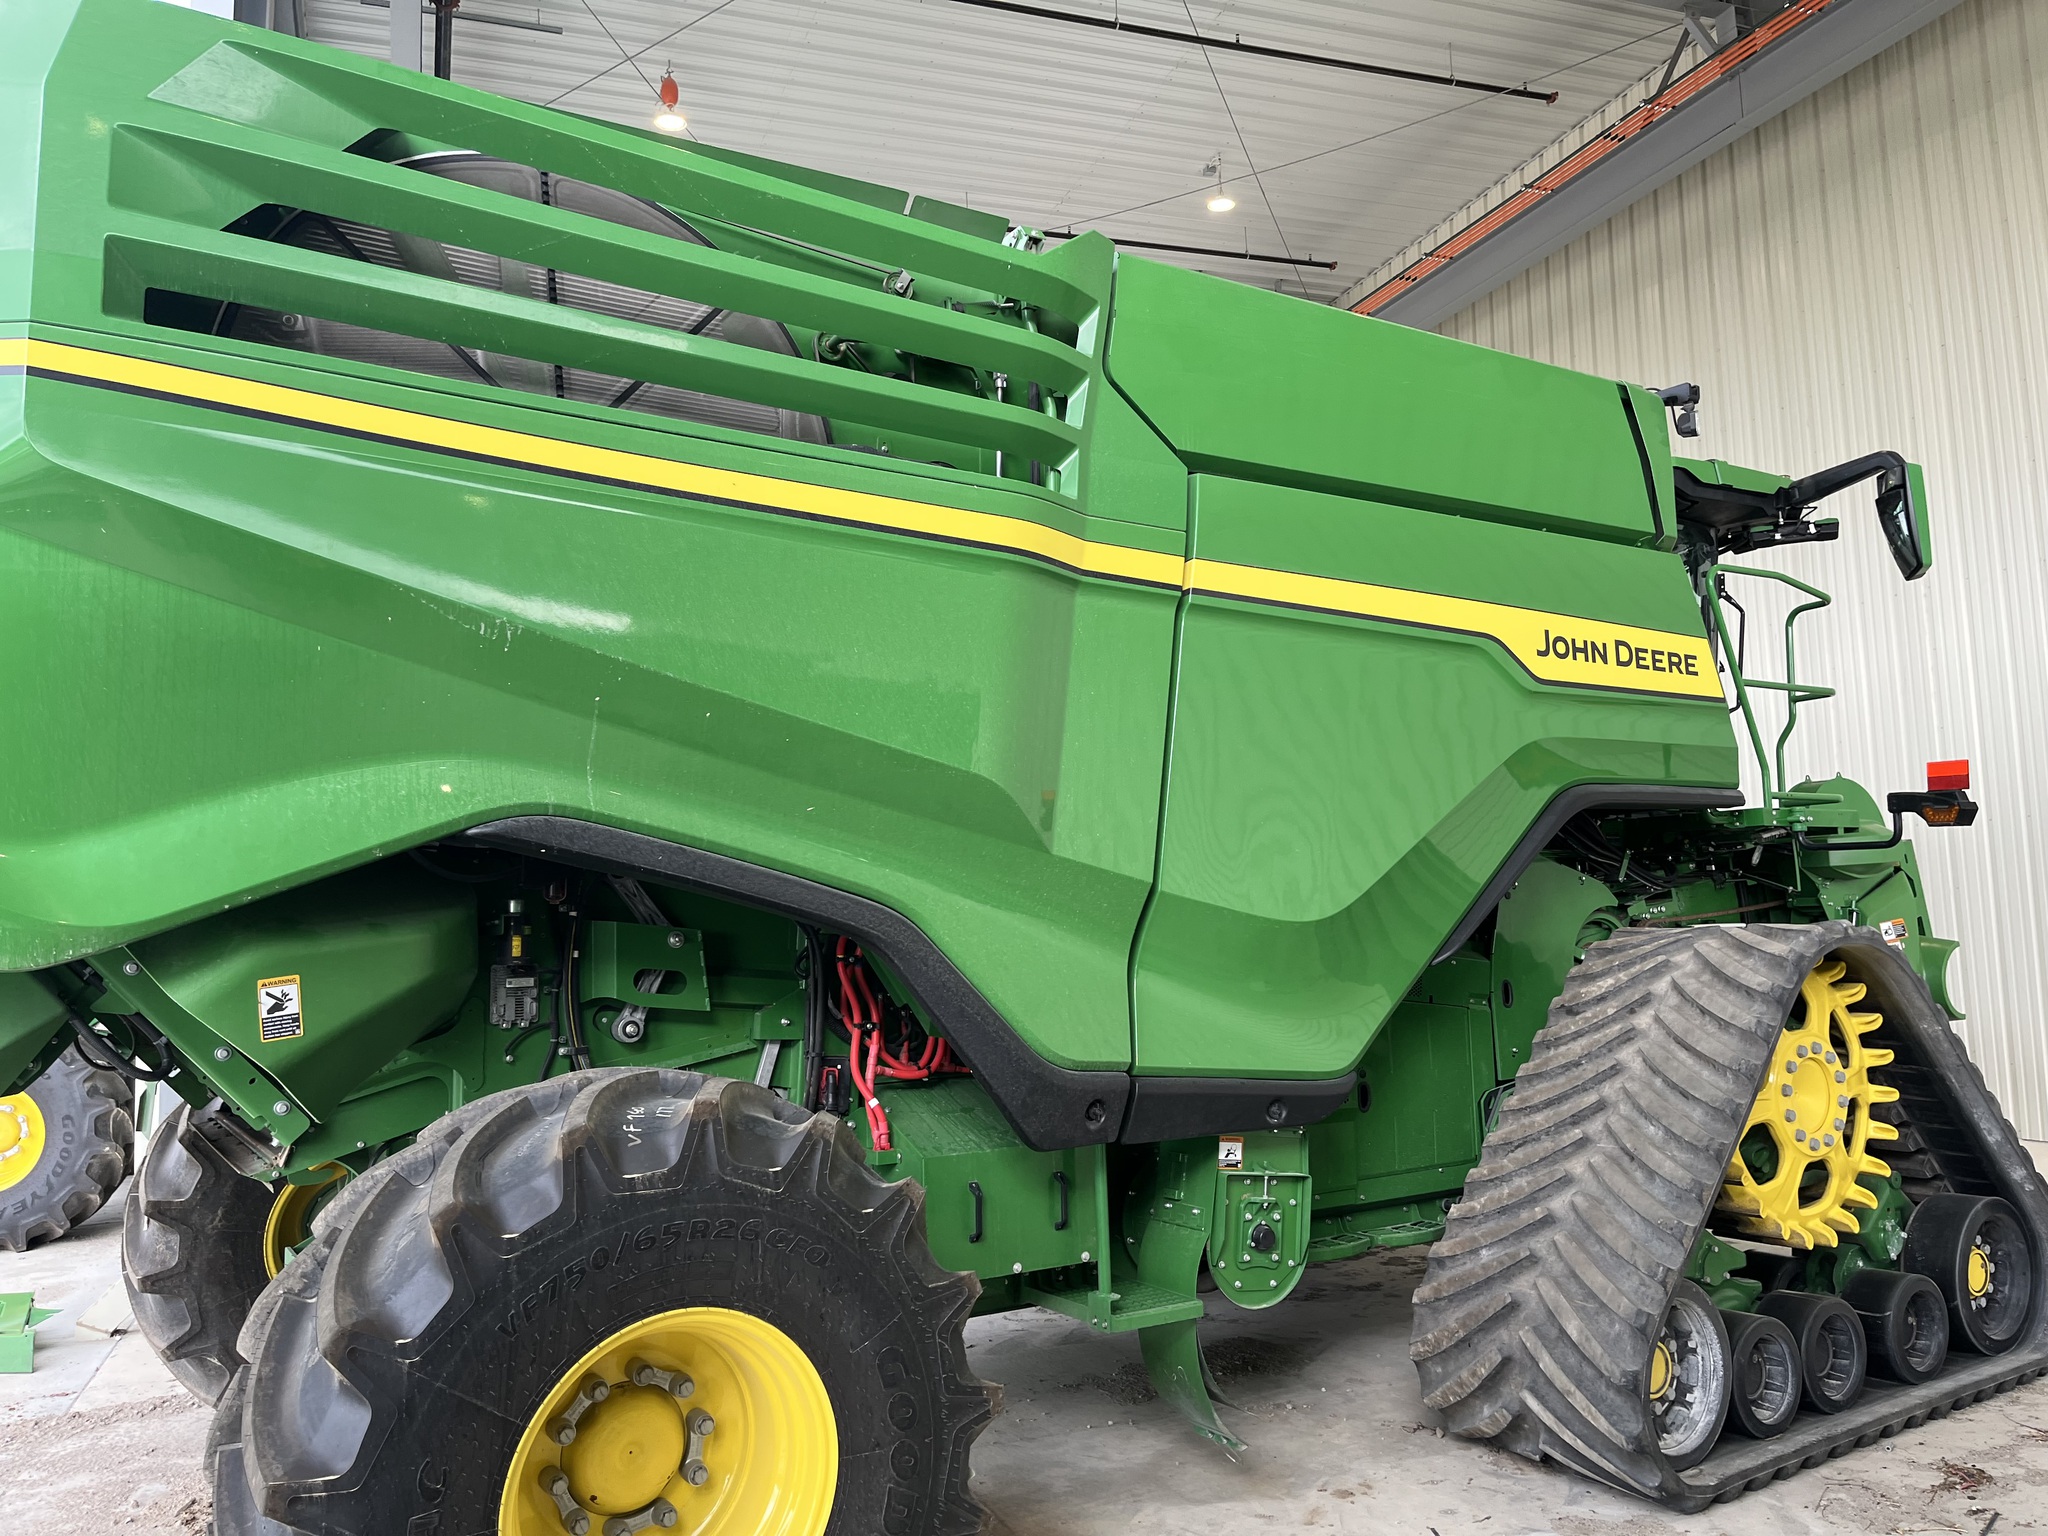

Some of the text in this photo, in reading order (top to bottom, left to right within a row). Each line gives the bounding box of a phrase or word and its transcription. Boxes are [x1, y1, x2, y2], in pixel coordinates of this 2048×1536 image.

[1536, 629, 1699, 677] JOHN DEERE
[268, 978, 297, 987] WARNING
